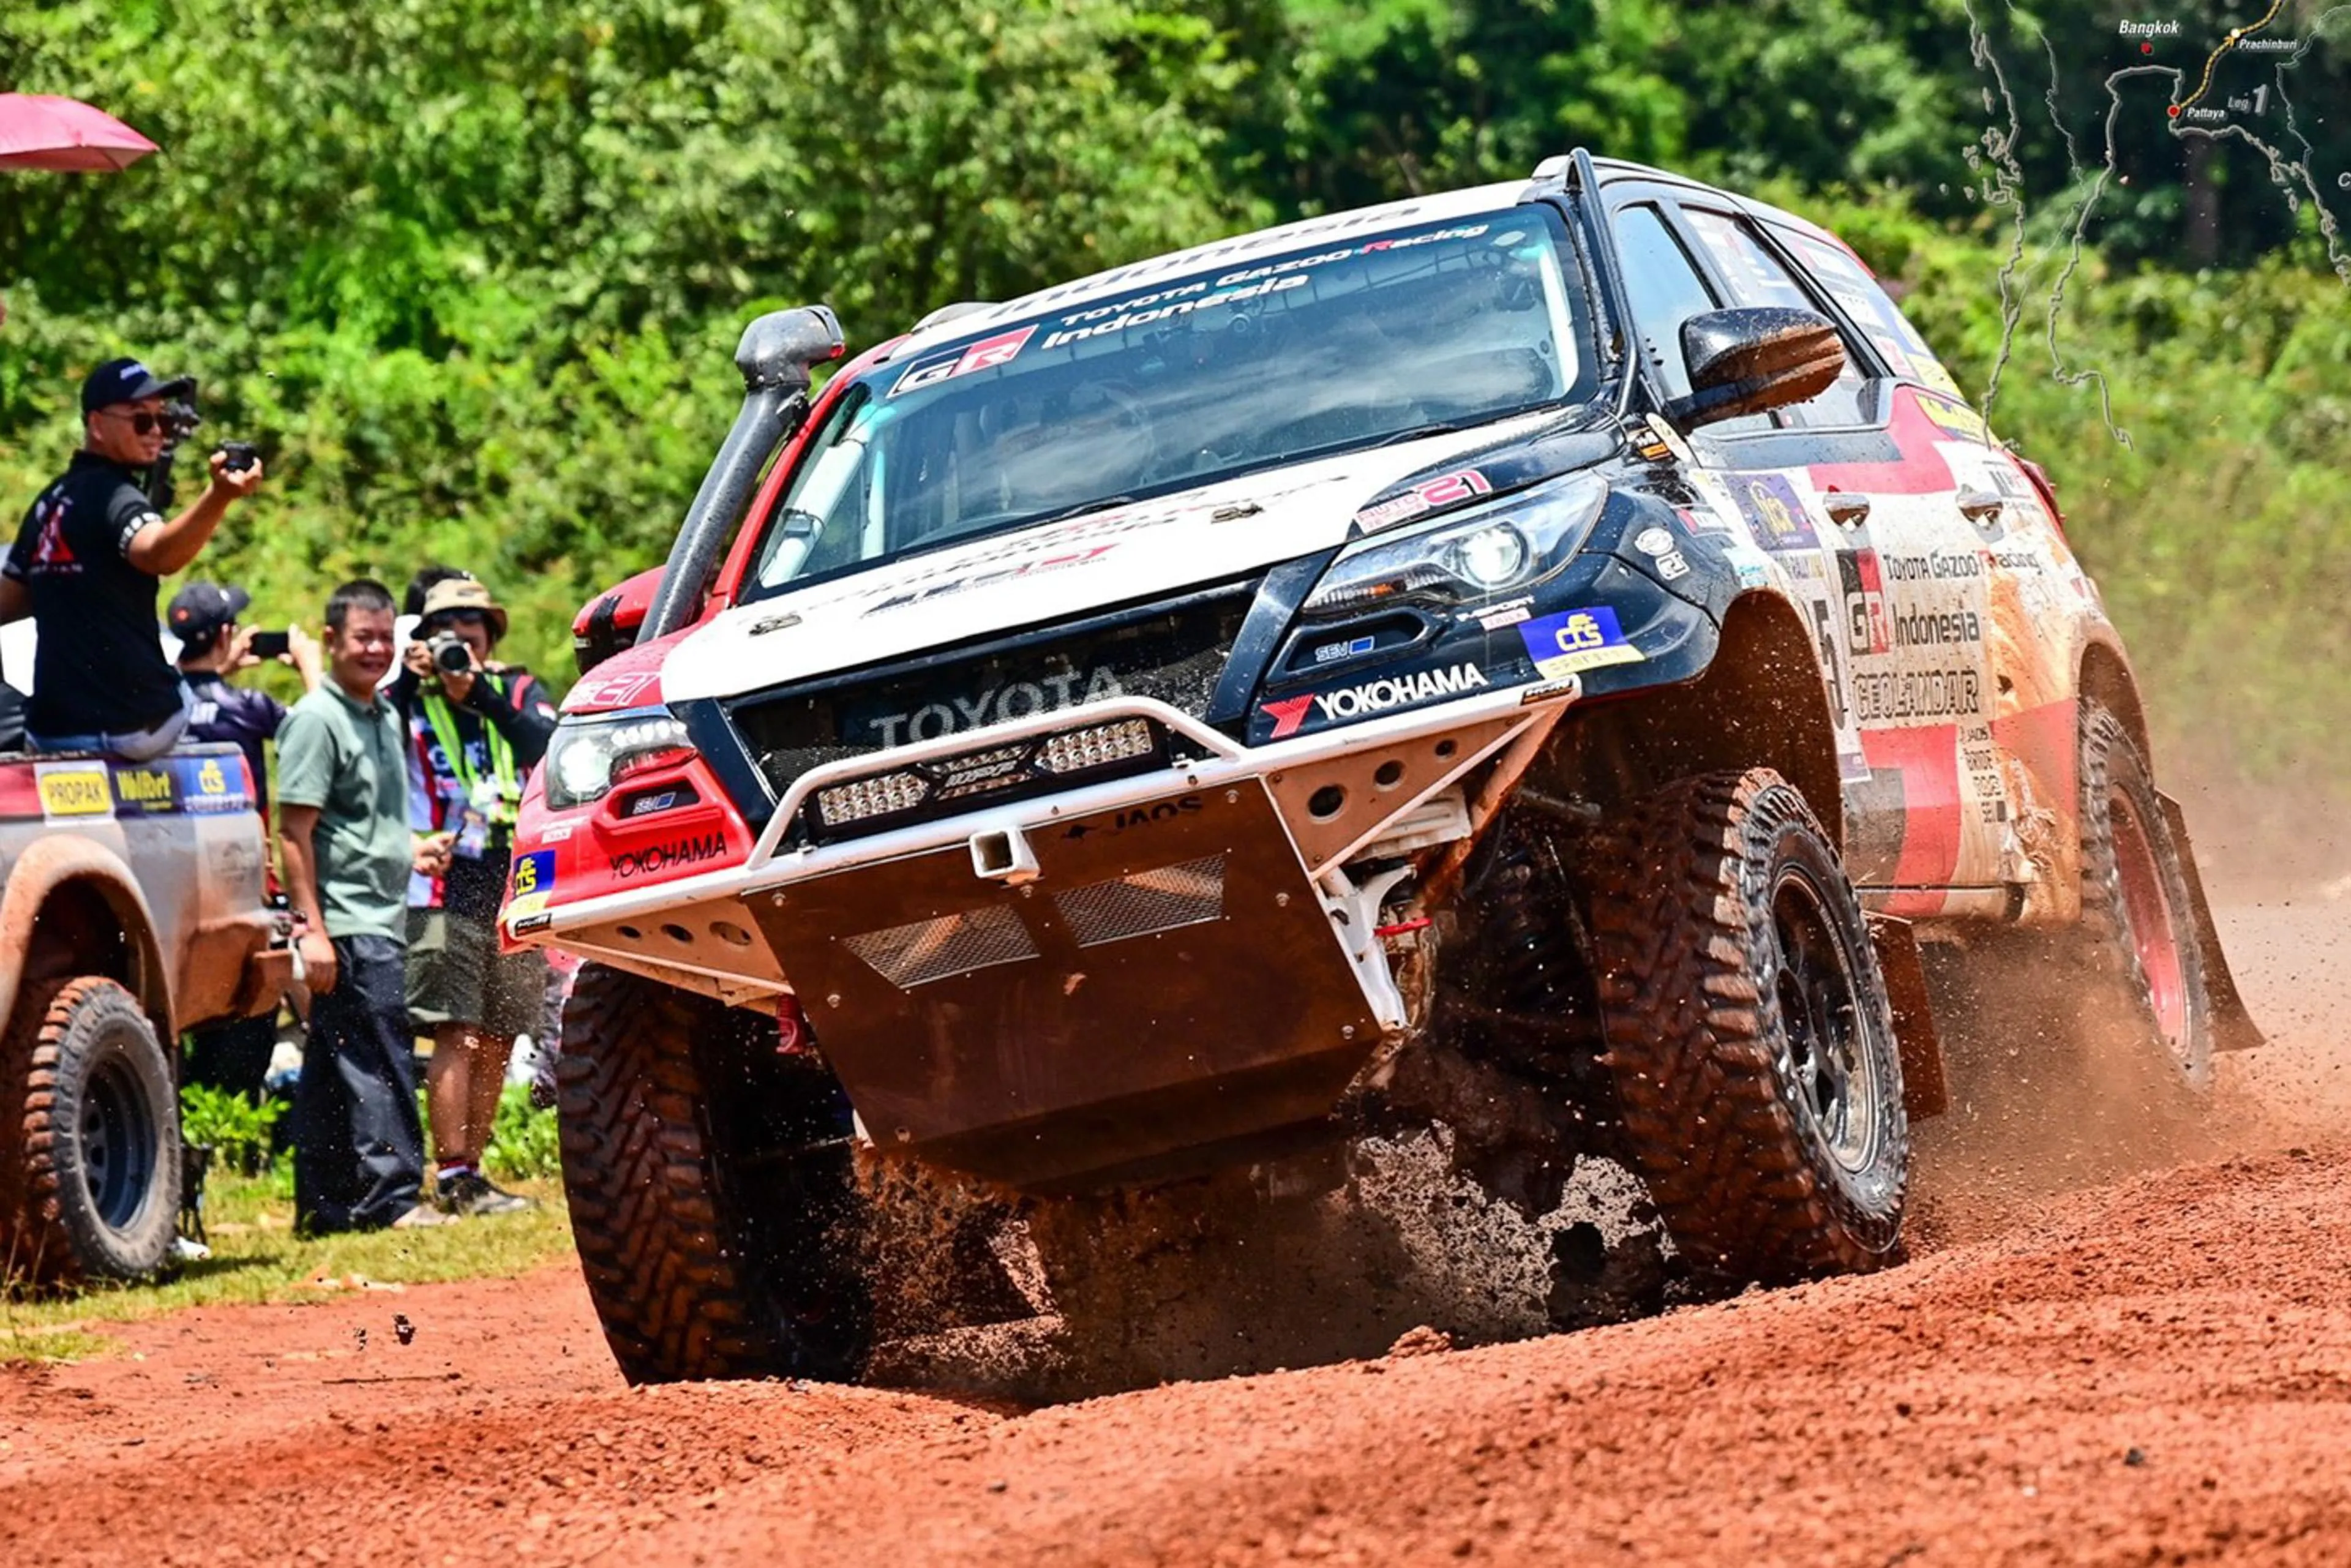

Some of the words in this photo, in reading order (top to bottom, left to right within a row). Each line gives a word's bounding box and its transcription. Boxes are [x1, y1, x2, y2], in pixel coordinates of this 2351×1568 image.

[1060, 282, 1207, 326] TOYOTA
[1216, 249, 1353, 285] GAZOO
[1363, 224, 1490, 254] Racing
[1042, 274, 1310, 349] Indonesia
[891, 338, 1018, 396] GR
[1417, 469, 1490, 505] 21
[1883, 553, 1930, 582] TOYOTA
[1930, 549, 1979, 580] GAZOO
[1846, 591, 1889, 651] GR
[1892, 602, 1981, 647] Indonesia
[869, 665, 1123, 750] TOYOTA
[1314, 662, 1490, 721] YOKOHAMA
[1853, 669, 1980, 722] GEOLANDAR
[48, 779, 103, 809] PROPAK
[609, 830, 727, 880] YOKOHAMA
